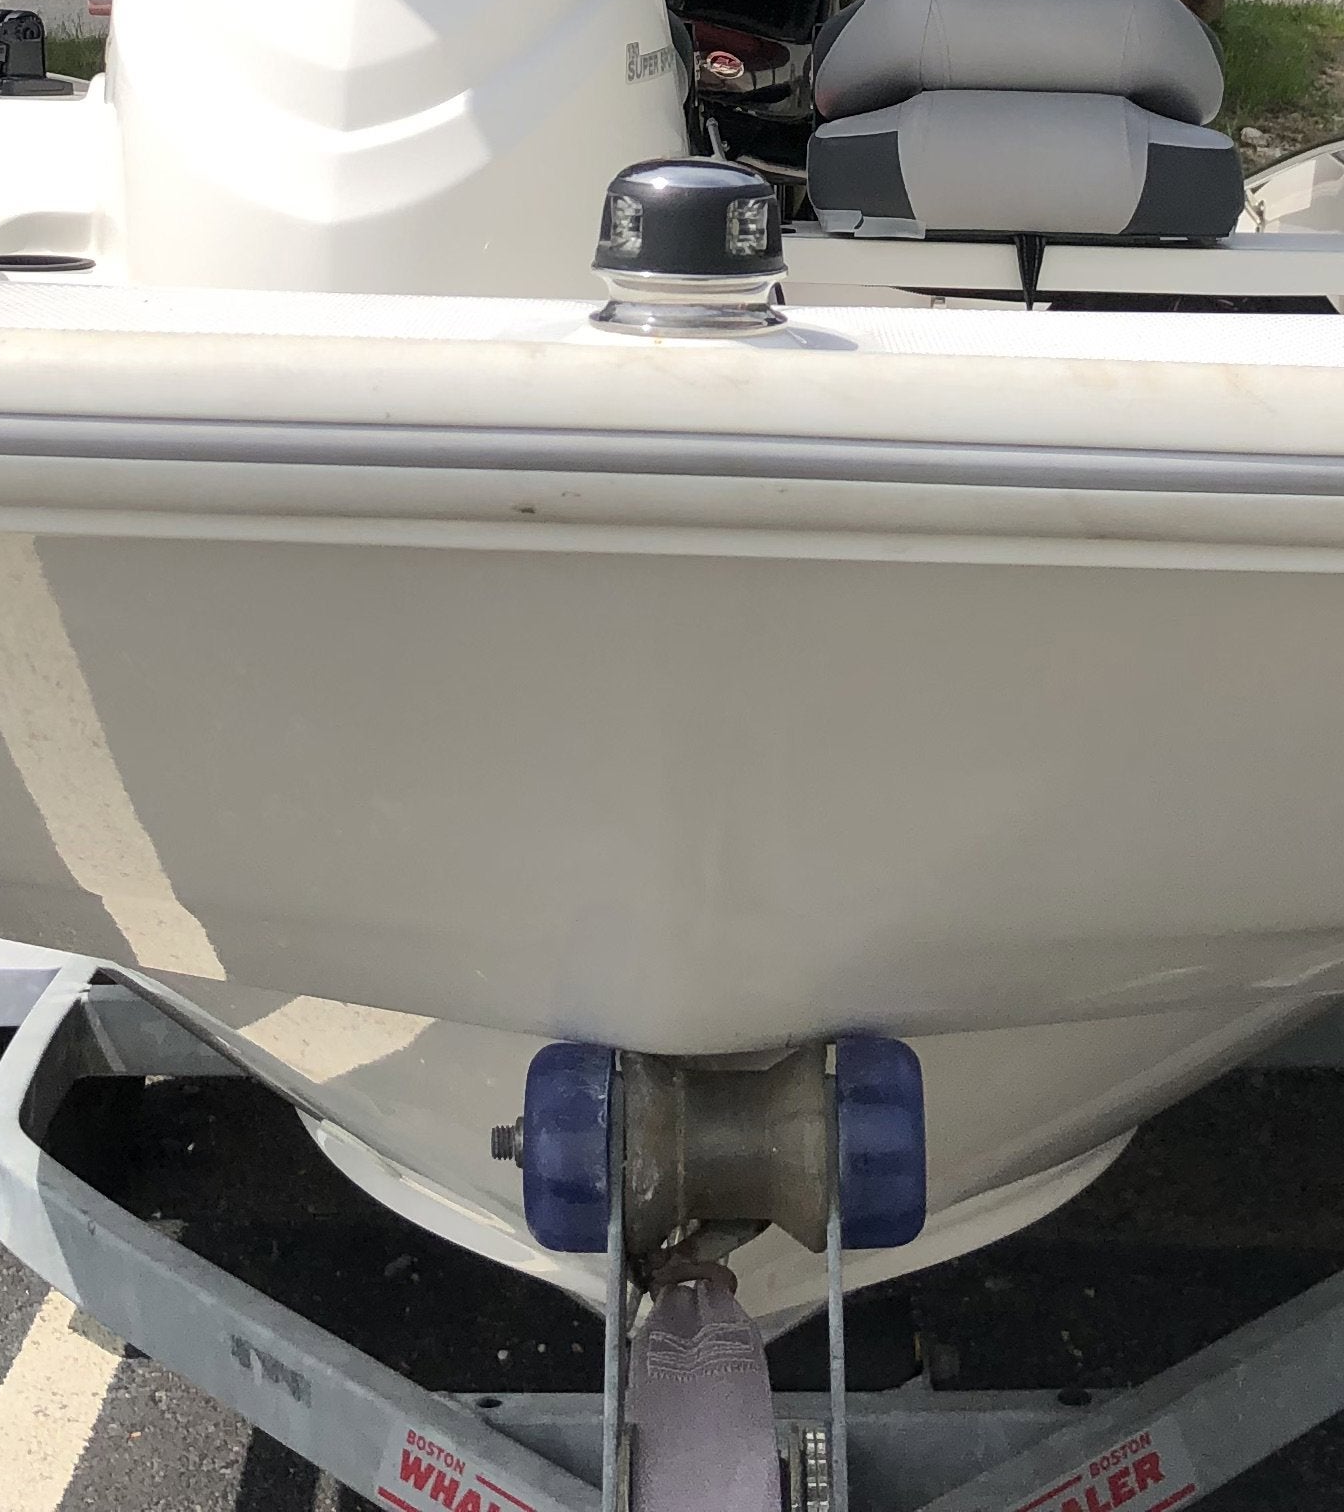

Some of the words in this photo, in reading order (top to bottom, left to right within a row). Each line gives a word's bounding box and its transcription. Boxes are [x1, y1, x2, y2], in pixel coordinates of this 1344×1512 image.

[627, 53, 659, 82] SUPER
[406, 1429, 466, 1476] BOSTON
[1088, 1431, 1153, 1479] BOSTON
